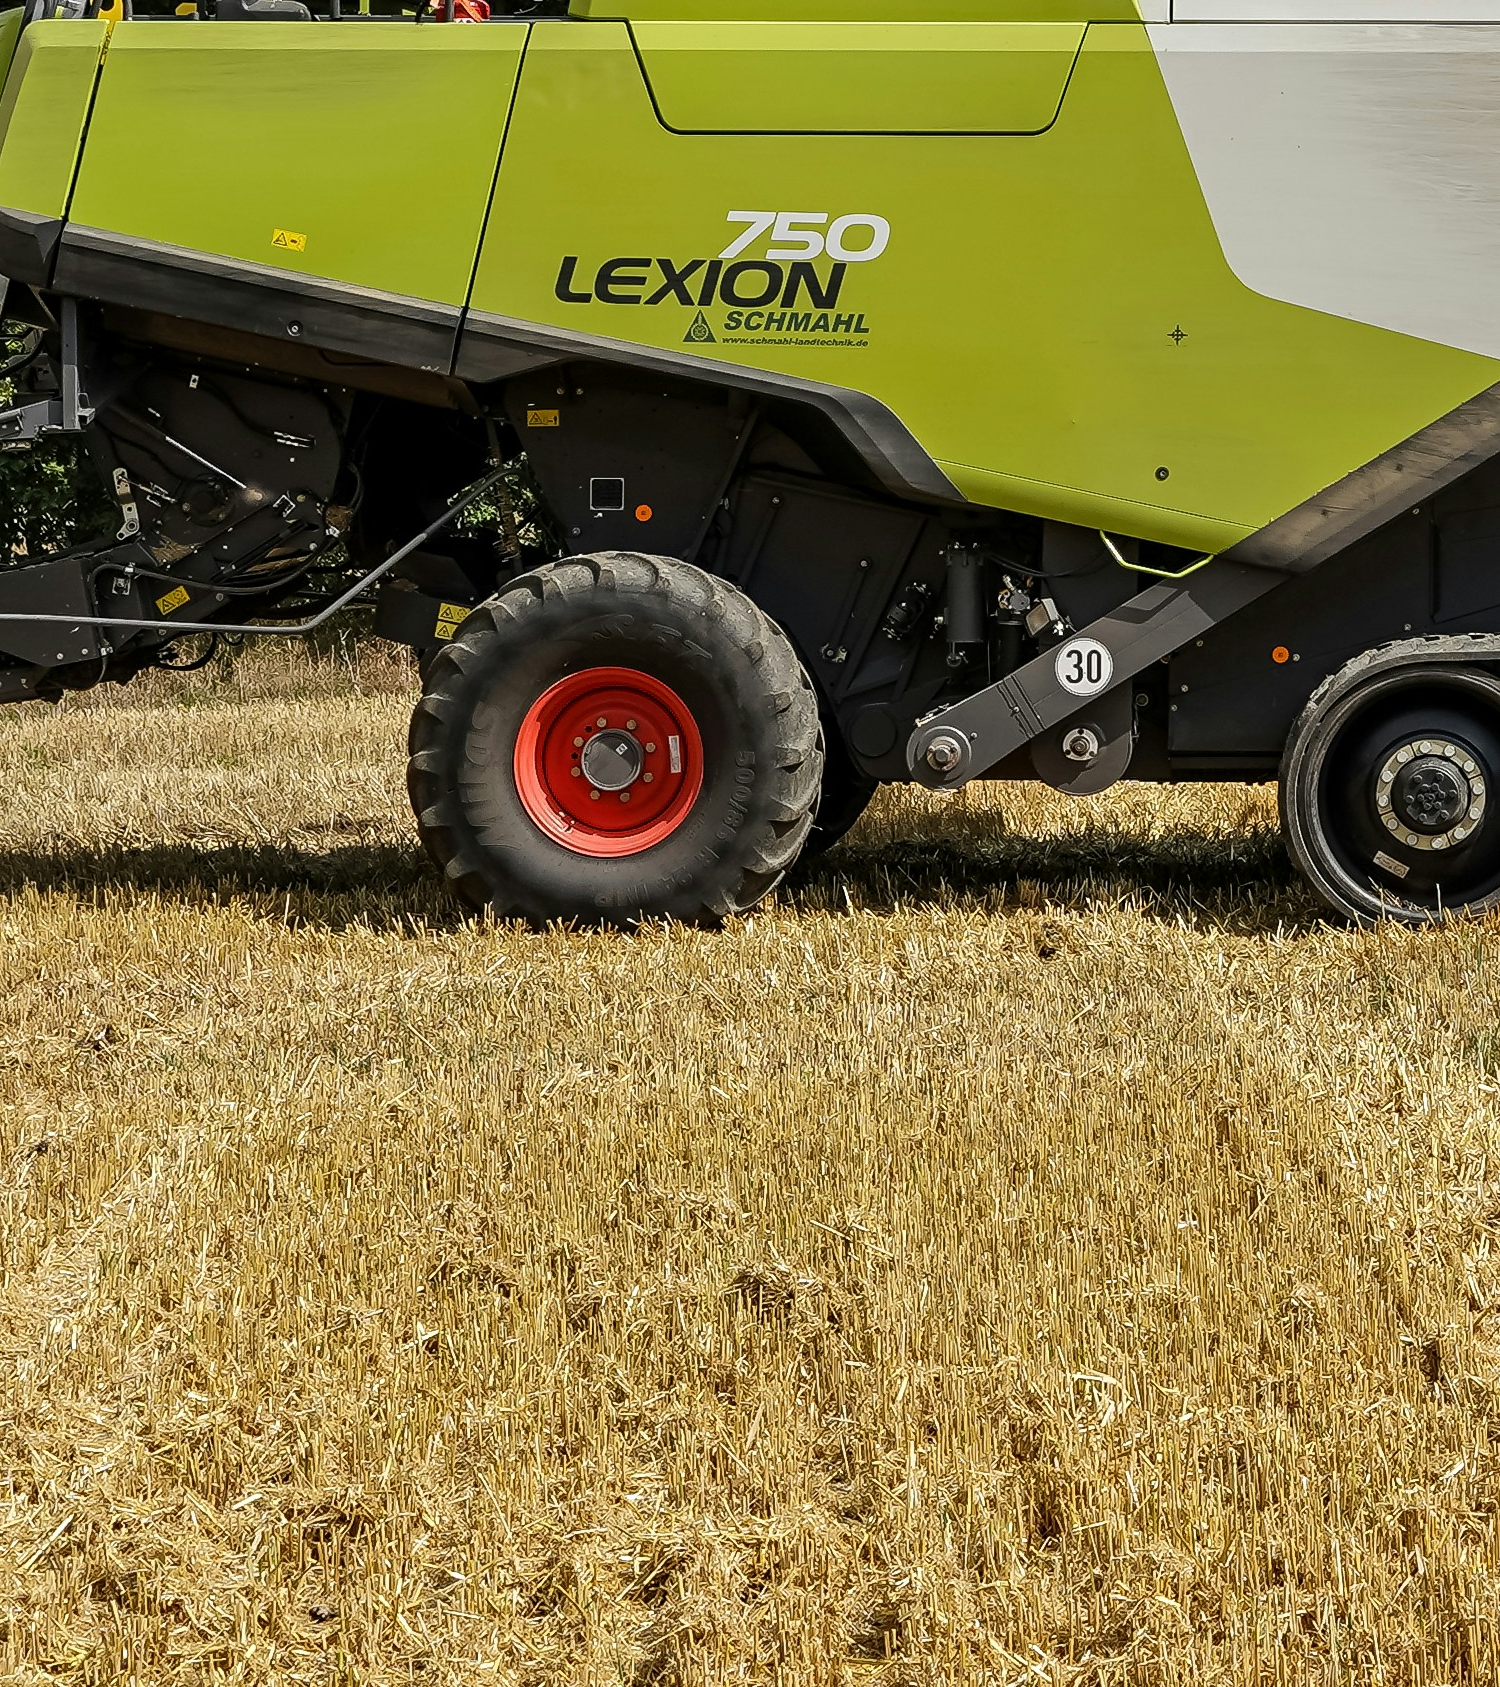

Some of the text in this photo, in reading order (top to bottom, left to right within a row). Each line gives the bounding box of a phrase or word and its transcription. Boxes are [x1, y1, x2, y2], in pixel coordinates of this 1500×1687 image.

[718, 210, 891, 261] 750
[554, 256, 847, 309] LEXION
[724, 311, 870, 333] SCHMAHL
[722, 336, 869, 347] www.schmahl-landtechnik.de
[1065, 649, 1102, 683] 30
